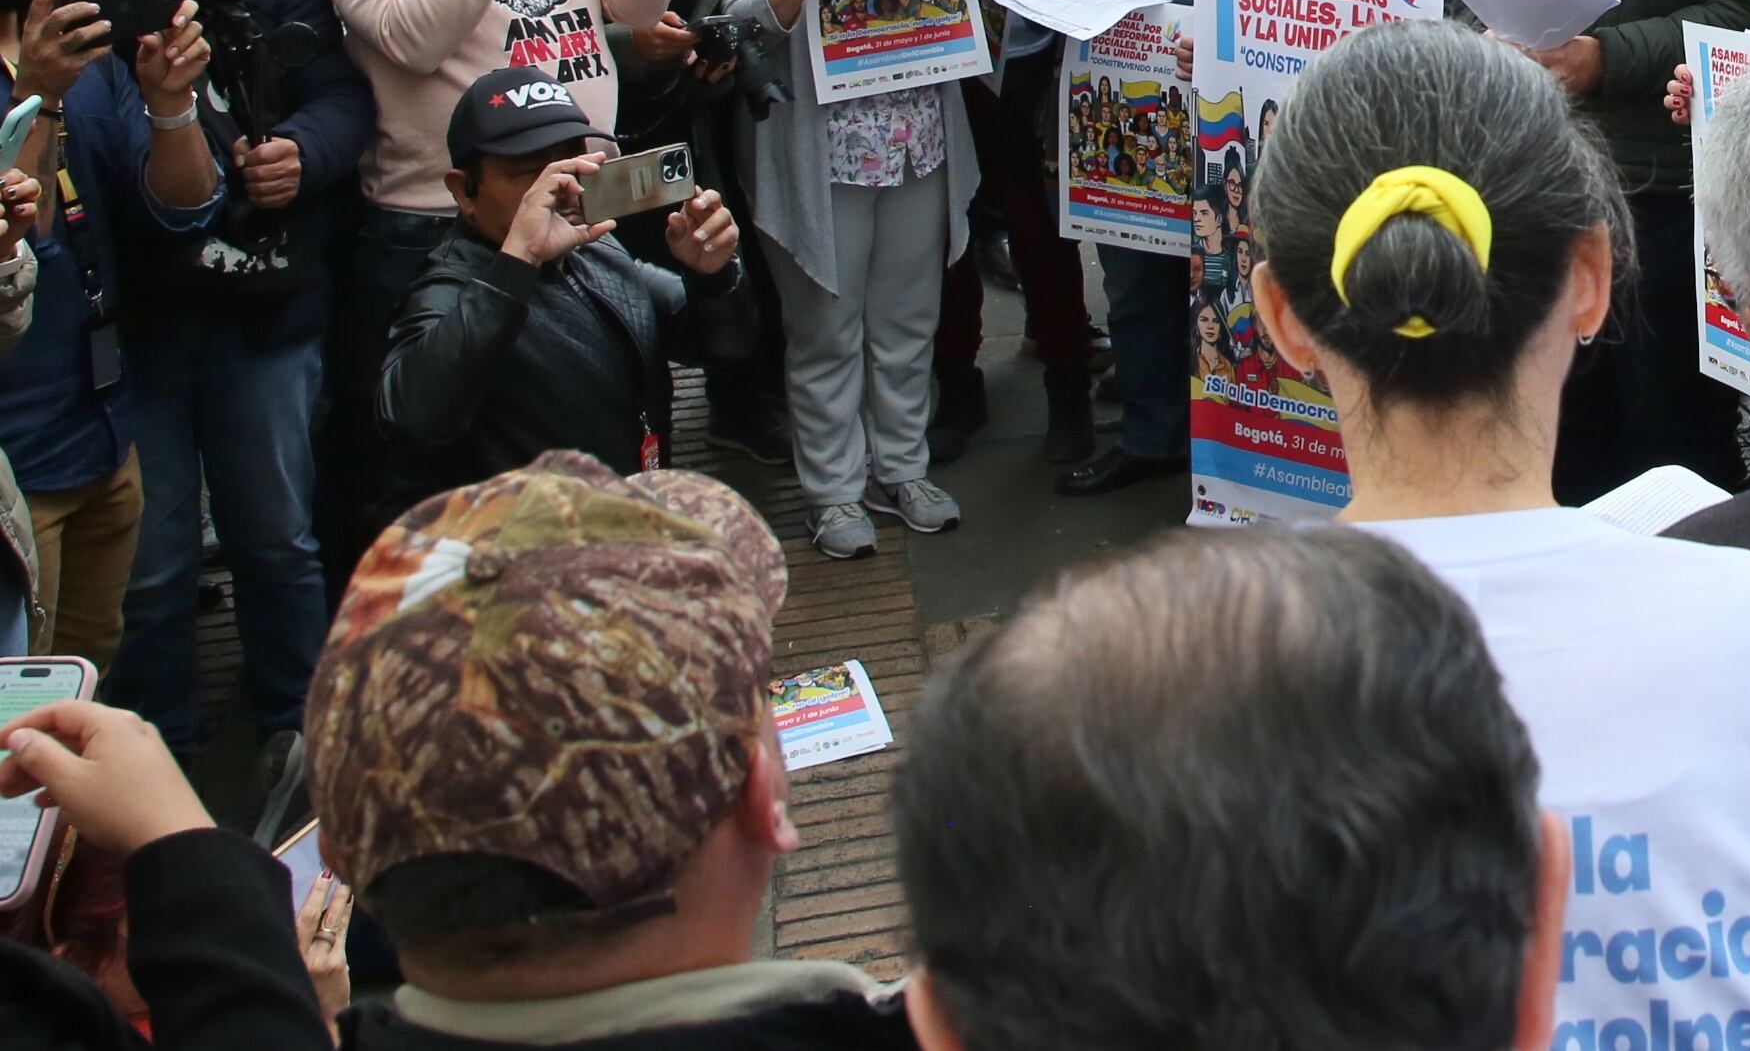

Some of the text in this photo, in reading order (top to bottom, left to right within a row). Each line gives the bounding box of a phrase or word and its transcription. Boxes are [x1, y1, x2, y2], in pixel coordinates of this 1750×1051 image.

[1352, 4, 1377, 27] LA
[883, 39, 893, 47] de
[893, 37, 913, 47] mayo
[923, 32, 933, 41] de
[933, 29, 951, 41] junio
[1113, 29, 1162, 44] REFORMAS
[1144, 24, 1162, 34] POR
[1239, 14, 1351, 52] Y LA UNID
[1091, 45, 1149, 62] Y LA UNIDAD
[1141, 44, 1153, 53] LA
[506, 82, 572, 107] VOZ
[1228, 384, 1239, 399] a
[1240, 384, 1255, 404] la
[1258, 390, 1339, 422] Democra
[1234, 422, 1287, 449] Bogotá,
[1291, 435, 1305, 449] 31
[1308, 438, 1326, 455] de
[807, 710, 818, 719] de
[819, 705, 840, 717] junio
[1572, 815, 1651, 895] la
